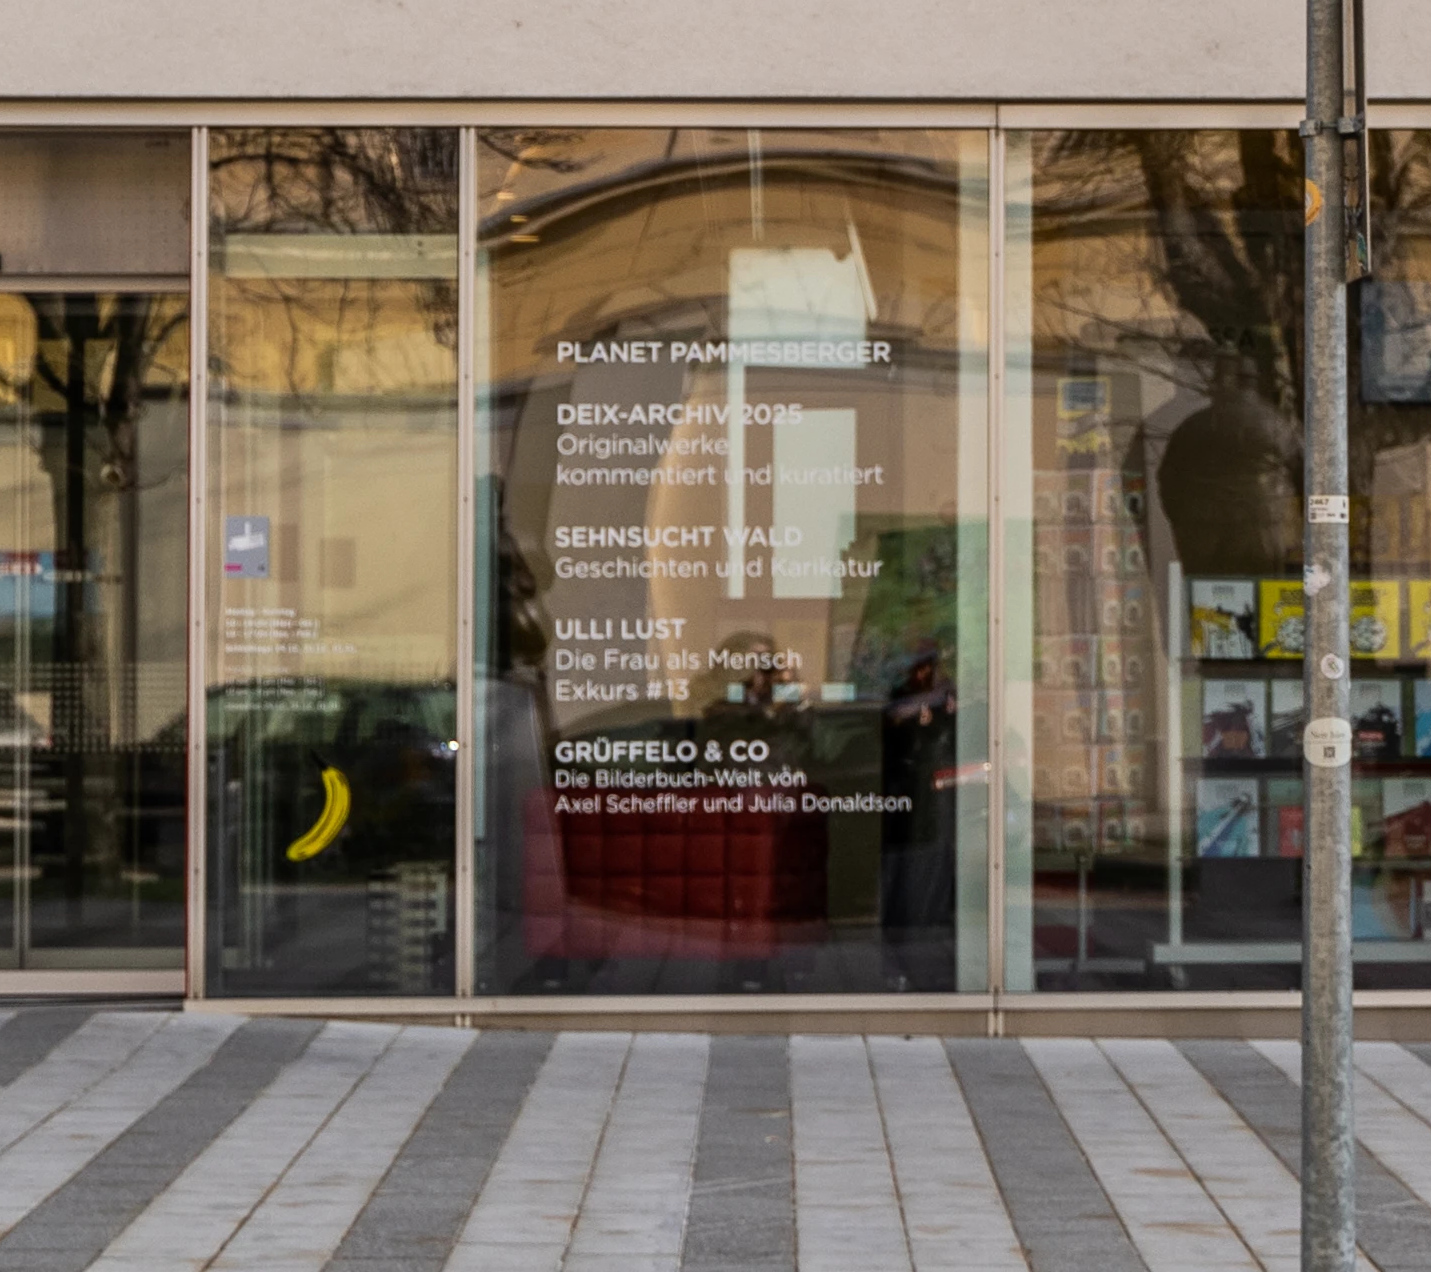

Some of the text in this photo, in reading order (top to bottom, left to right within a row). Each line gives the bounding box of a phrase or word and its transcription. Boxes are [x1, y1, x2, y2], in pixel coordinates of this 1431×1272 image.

[556, 341, 893, 364] PLANET PAMMESBERGER
[556, 403, 805, 426] DEIX-ARCHIV 2025
[556, 432, 730, 460] Originalwerke
[556, 463, 885, 486] kommentiert und kuratiert
[554, 525, 804, 549] SEHNSUCHT WALD
[554, 555, 885, 579] Geschichten und Karikatur
[554, 617, 688, 641] ULLI LUST
[554, 648, 804, 671] Die Frau als Mensch
[554, 678, 691, 702] Exkurs #13
[554, 736, 770, 764] GRÜFFELO & CO
[554, 769, 590, 789] Die
[595, 769, 762, 789] Bilderbuch-Welt
[554, 793, 913, 814] Axel Scheffler und Julia Donaldson
